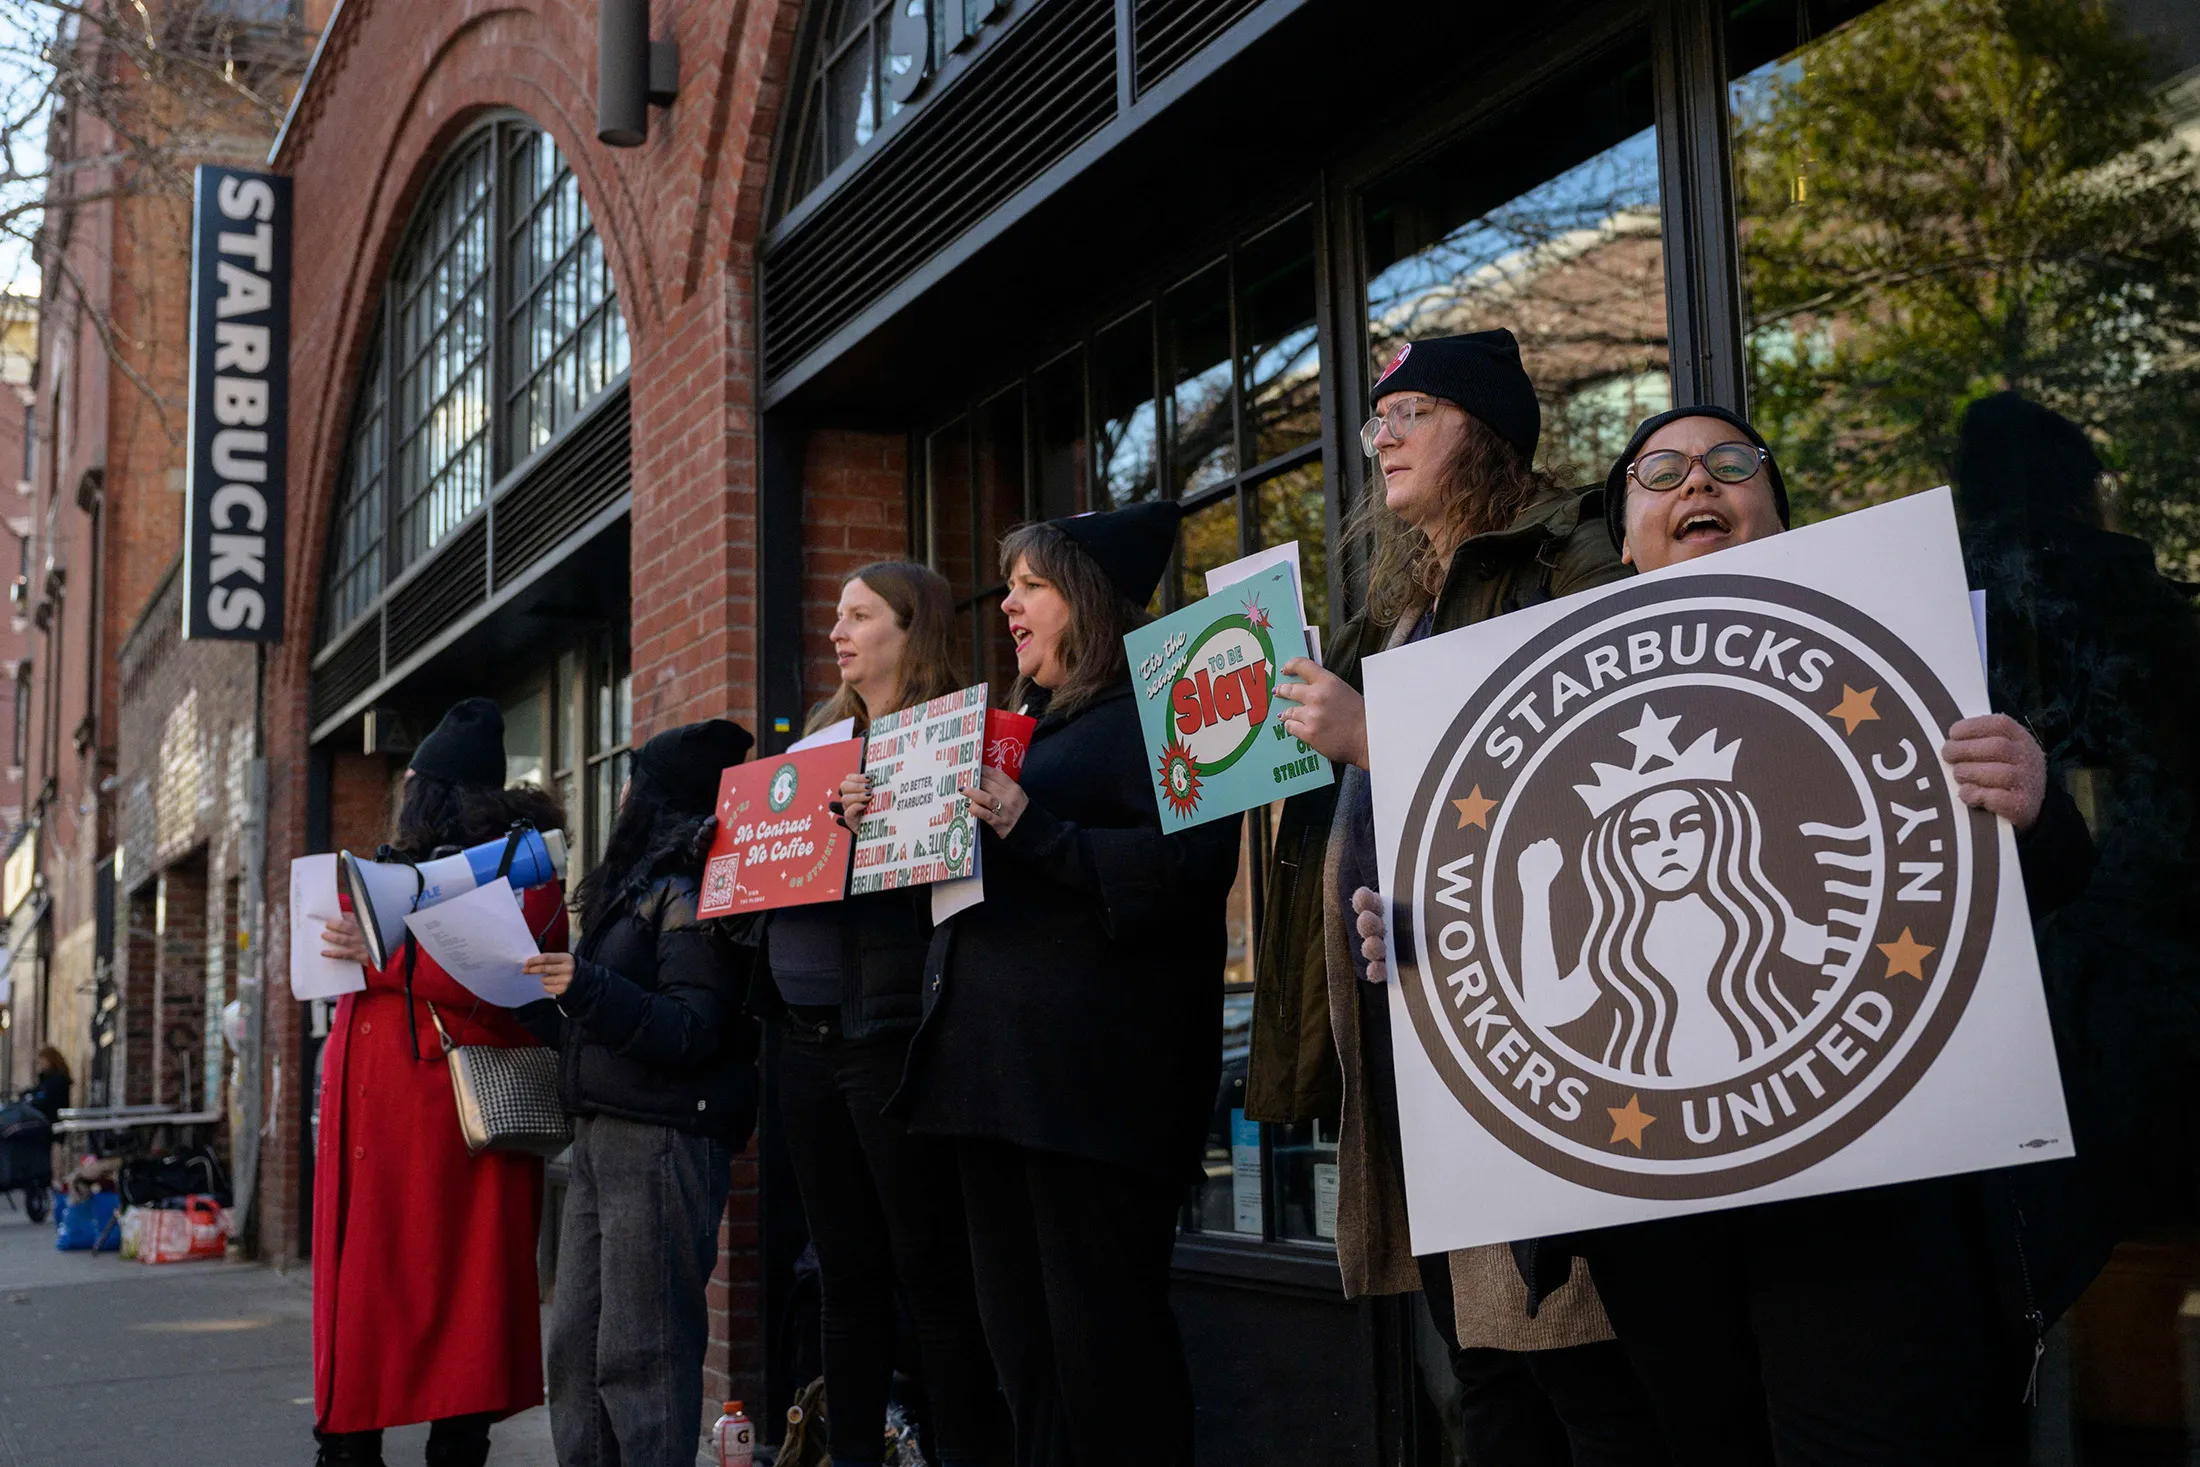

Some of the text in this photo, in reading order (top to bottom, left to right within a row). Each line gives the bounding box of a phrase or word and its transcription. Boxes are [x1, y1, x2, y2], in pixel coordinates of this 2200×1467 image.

[207, 174, 275, 632] STARBUCKS
[1163, 631, 1187, 660] the
[1208, 645, 1243, 673] TO BE
[1147, 654, 1188, 700] season
[1484, 623, 1835, 770] STARBUCKS
[962, 711, 977, 736] RED
[959, 741, 975, 765] RED
[1272, 754, 1320, 783] STRIKE!
[900, 782, 910, 794] DO
[910, 776, 933, 791] BETTER,
[897, 792, 934, 811] STARBUCKS!
[733, 814, 812, 846] No Contract
[745, 836, 814, 867] No Coffee
[1435, 854, 1589, 1123] WORKERS
[1682, 990, 1893, 1144] UNITED
[737, 1429, 750, 1444] G
